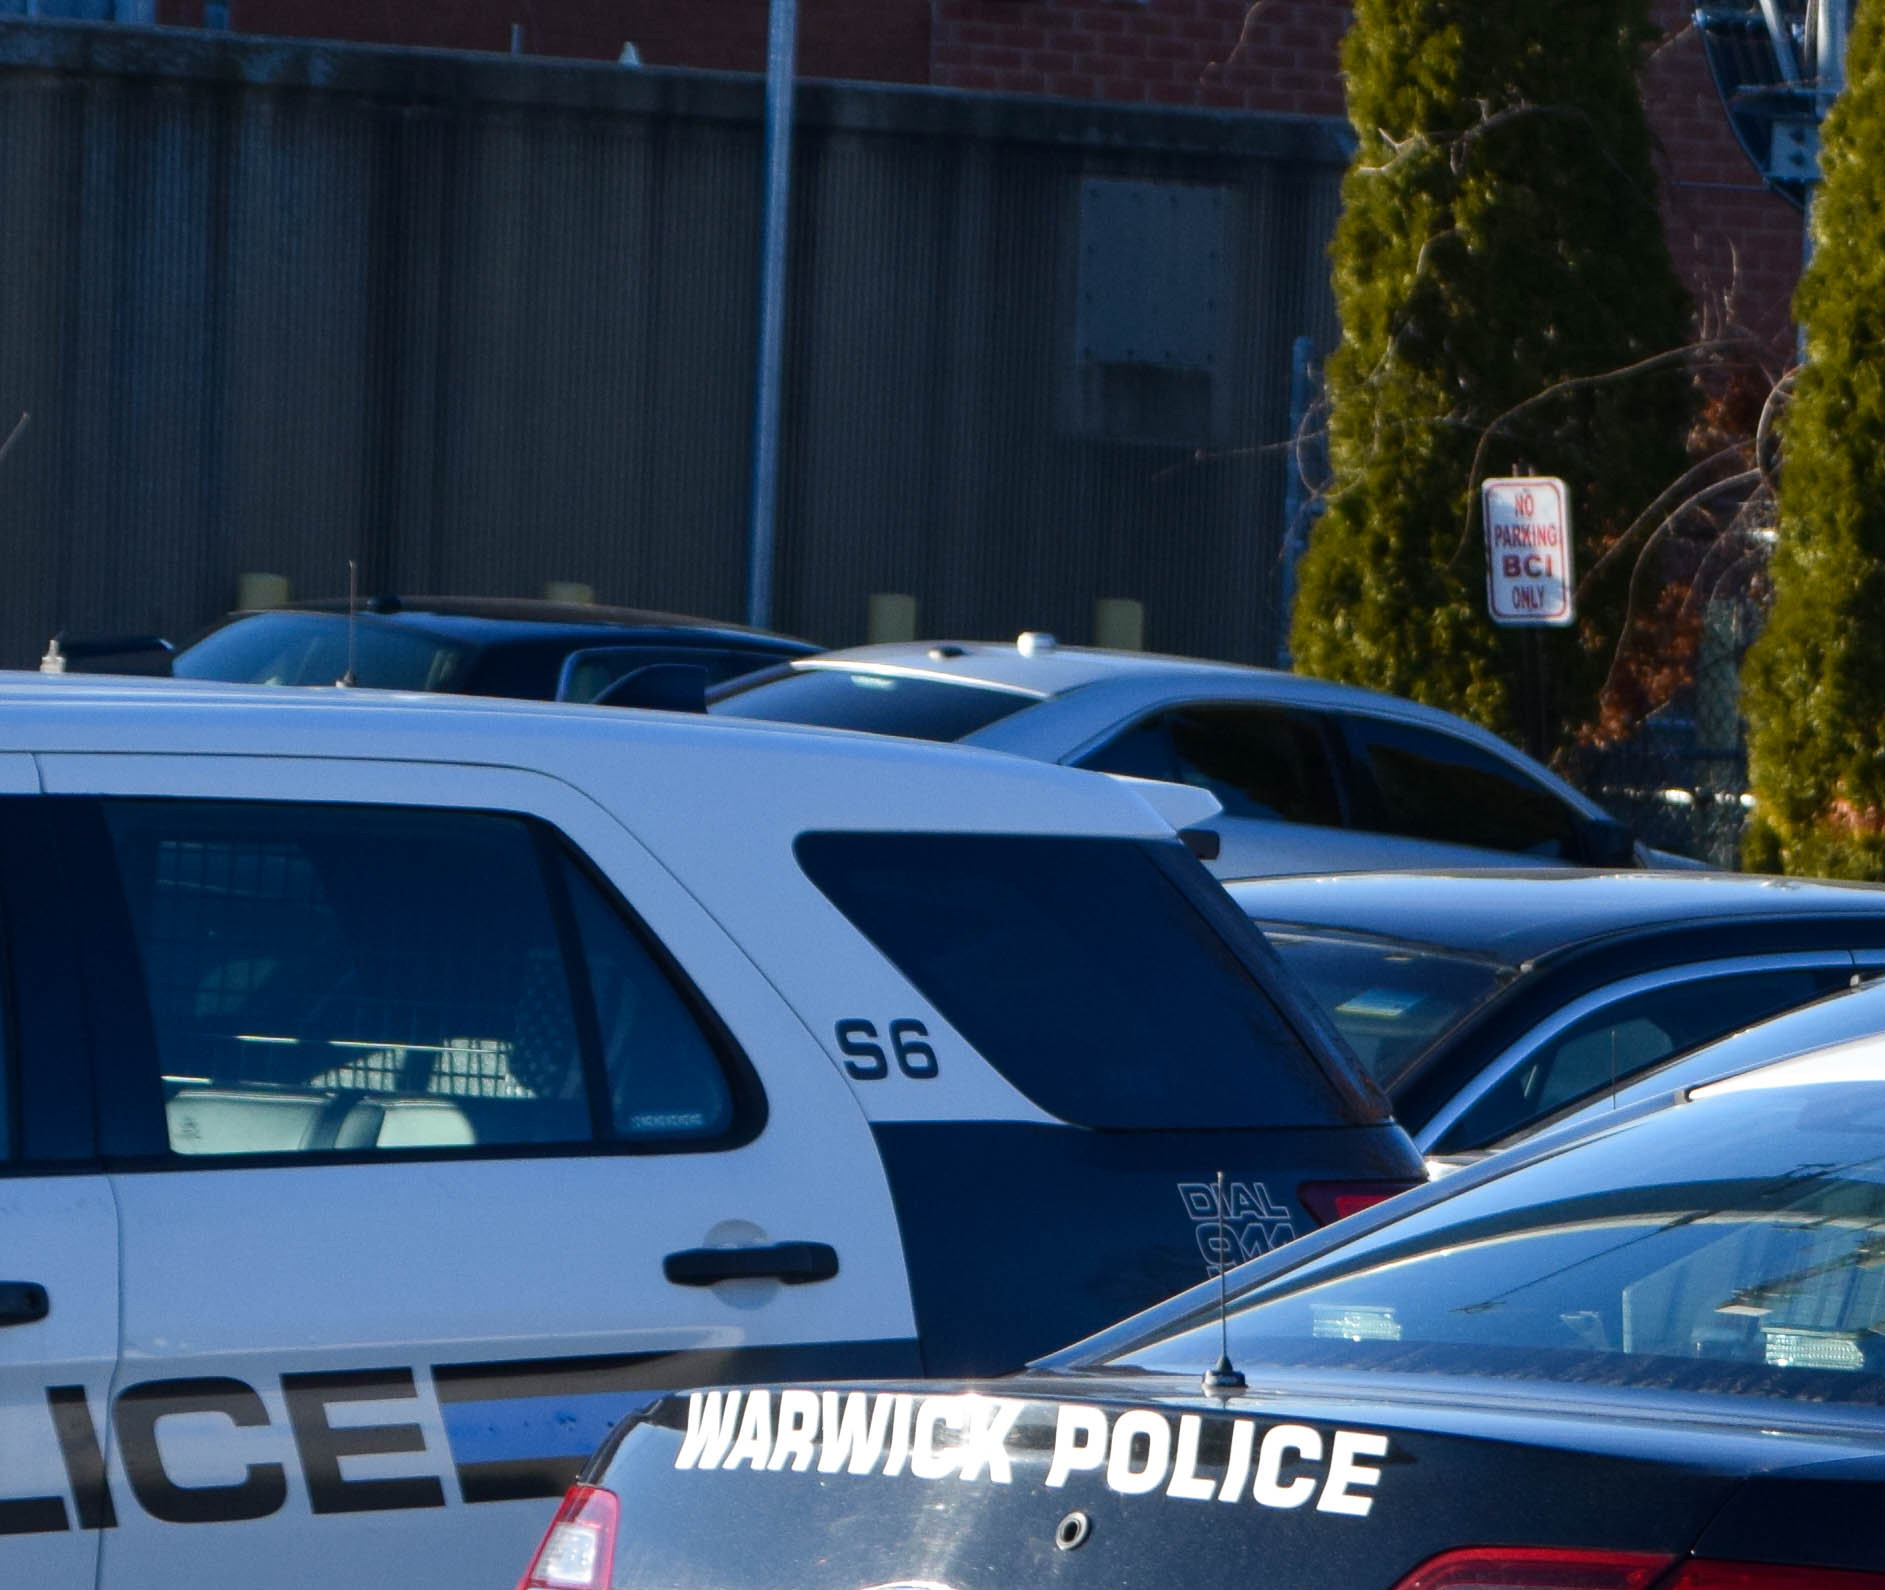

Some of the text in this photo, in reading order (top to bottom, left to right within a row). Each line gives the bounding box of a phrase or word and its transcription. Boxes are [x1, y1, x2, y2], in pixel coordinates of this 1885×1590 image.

[1514, 494, 1534, 517] NO
[1494, 525, 1558, 547] PARKING
[1503, 553, 1553, 577] BCI
[1511, 586, 1545, 609] ONLY
[834, 1018, 939, 1081] S6
[1177, 1182, 1291, 1220] DIAL
[674, 1390, 1390, 1517] WARWICK POLICE
